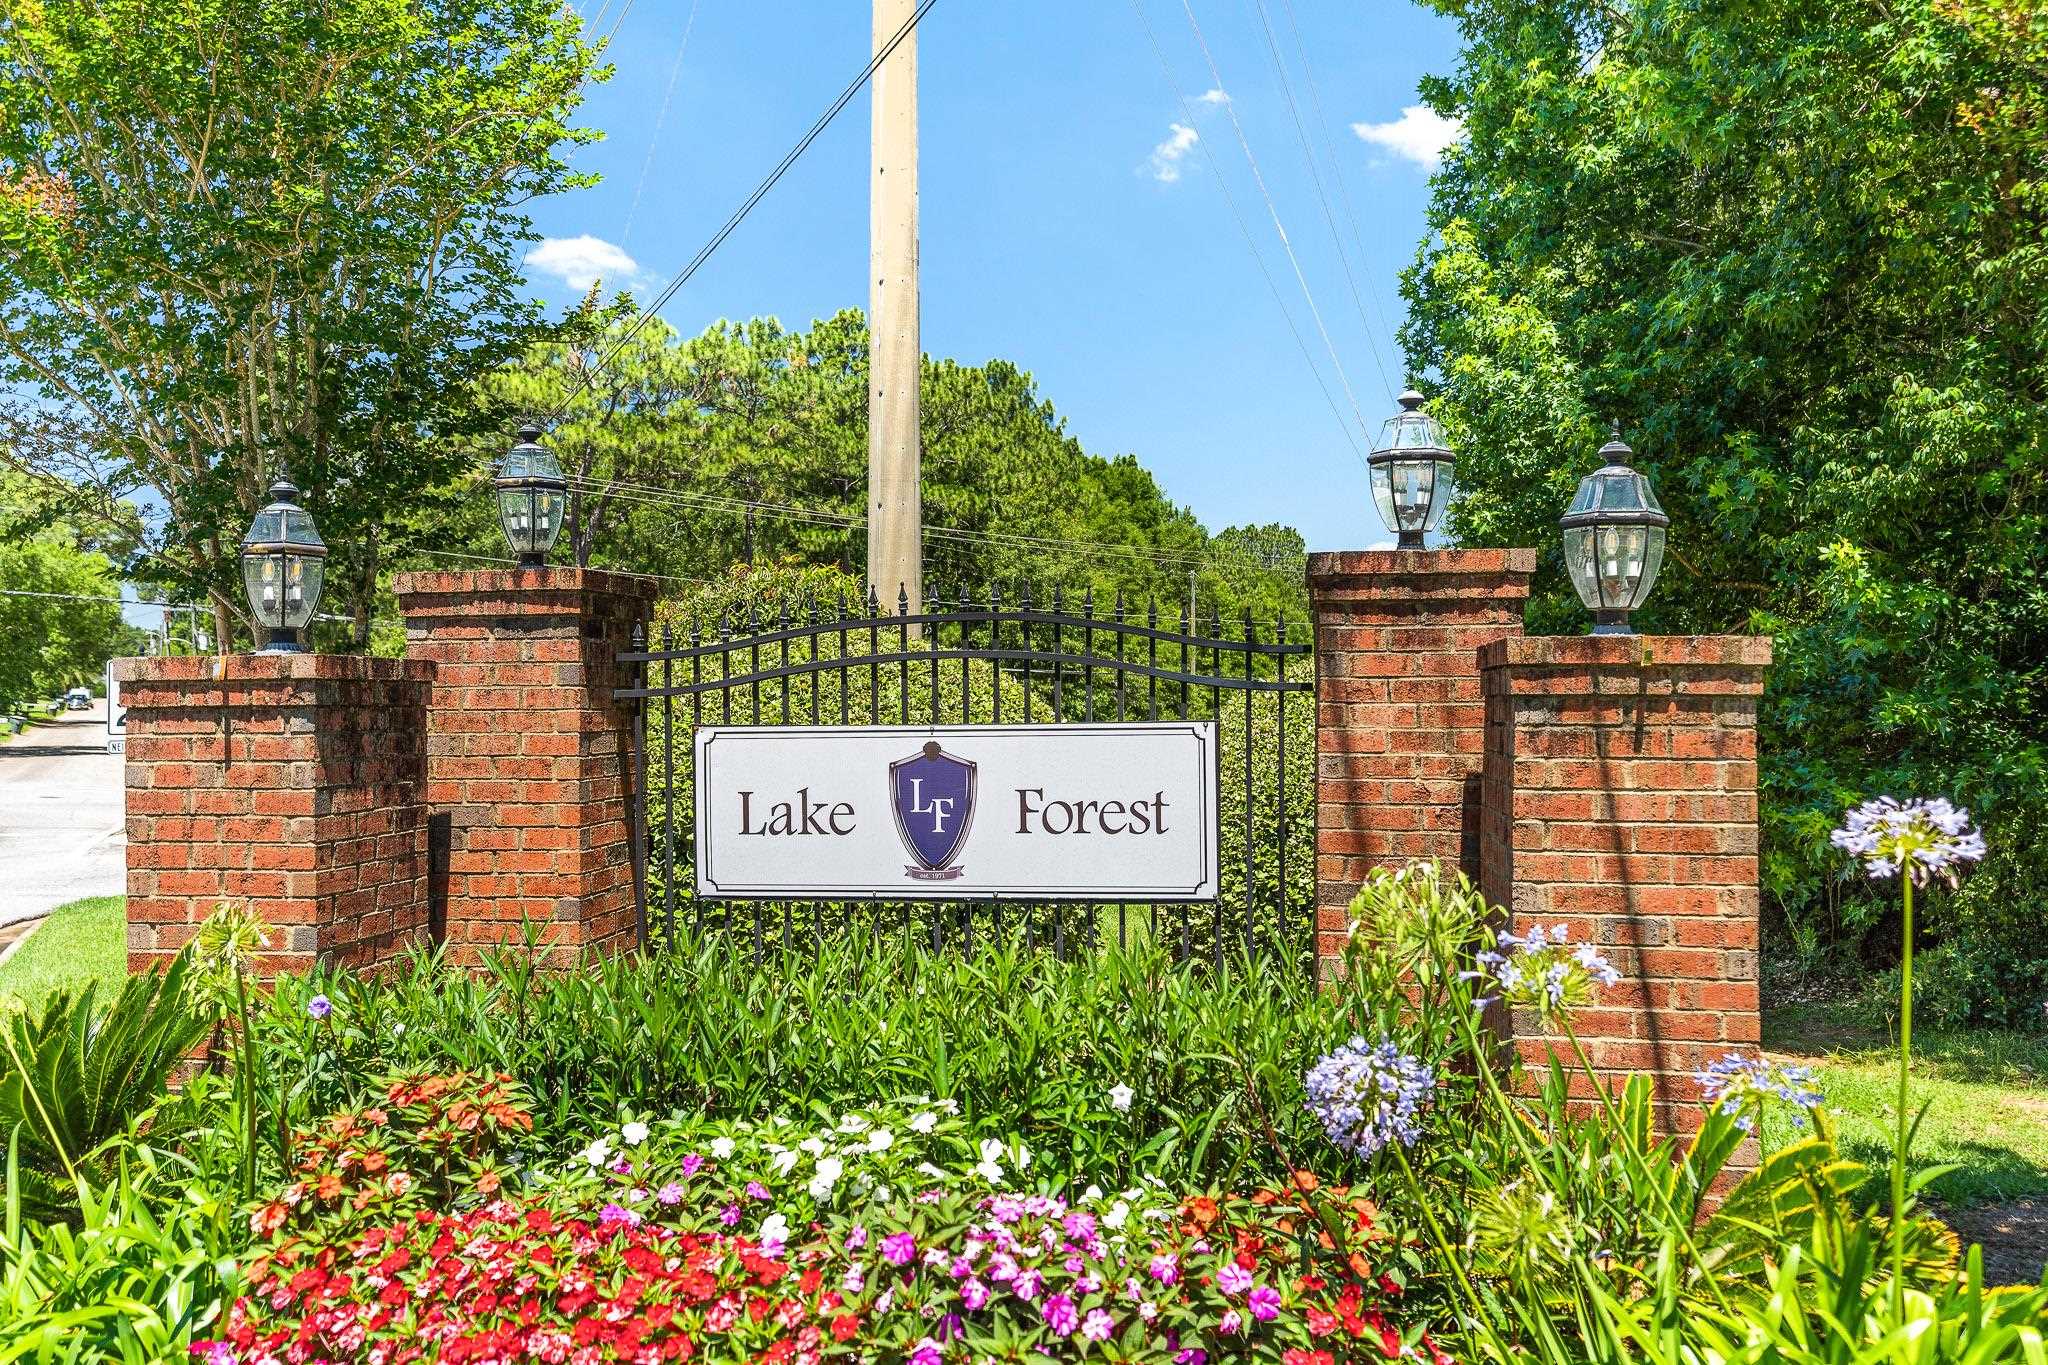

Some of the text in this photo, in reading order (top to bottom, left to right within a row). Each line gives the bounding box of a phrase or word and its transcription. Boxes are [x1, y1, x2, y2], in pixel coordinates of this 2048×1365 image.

[737, 787, 1170, 836] Lake Forest
[909, 778, 954, 833] LF
